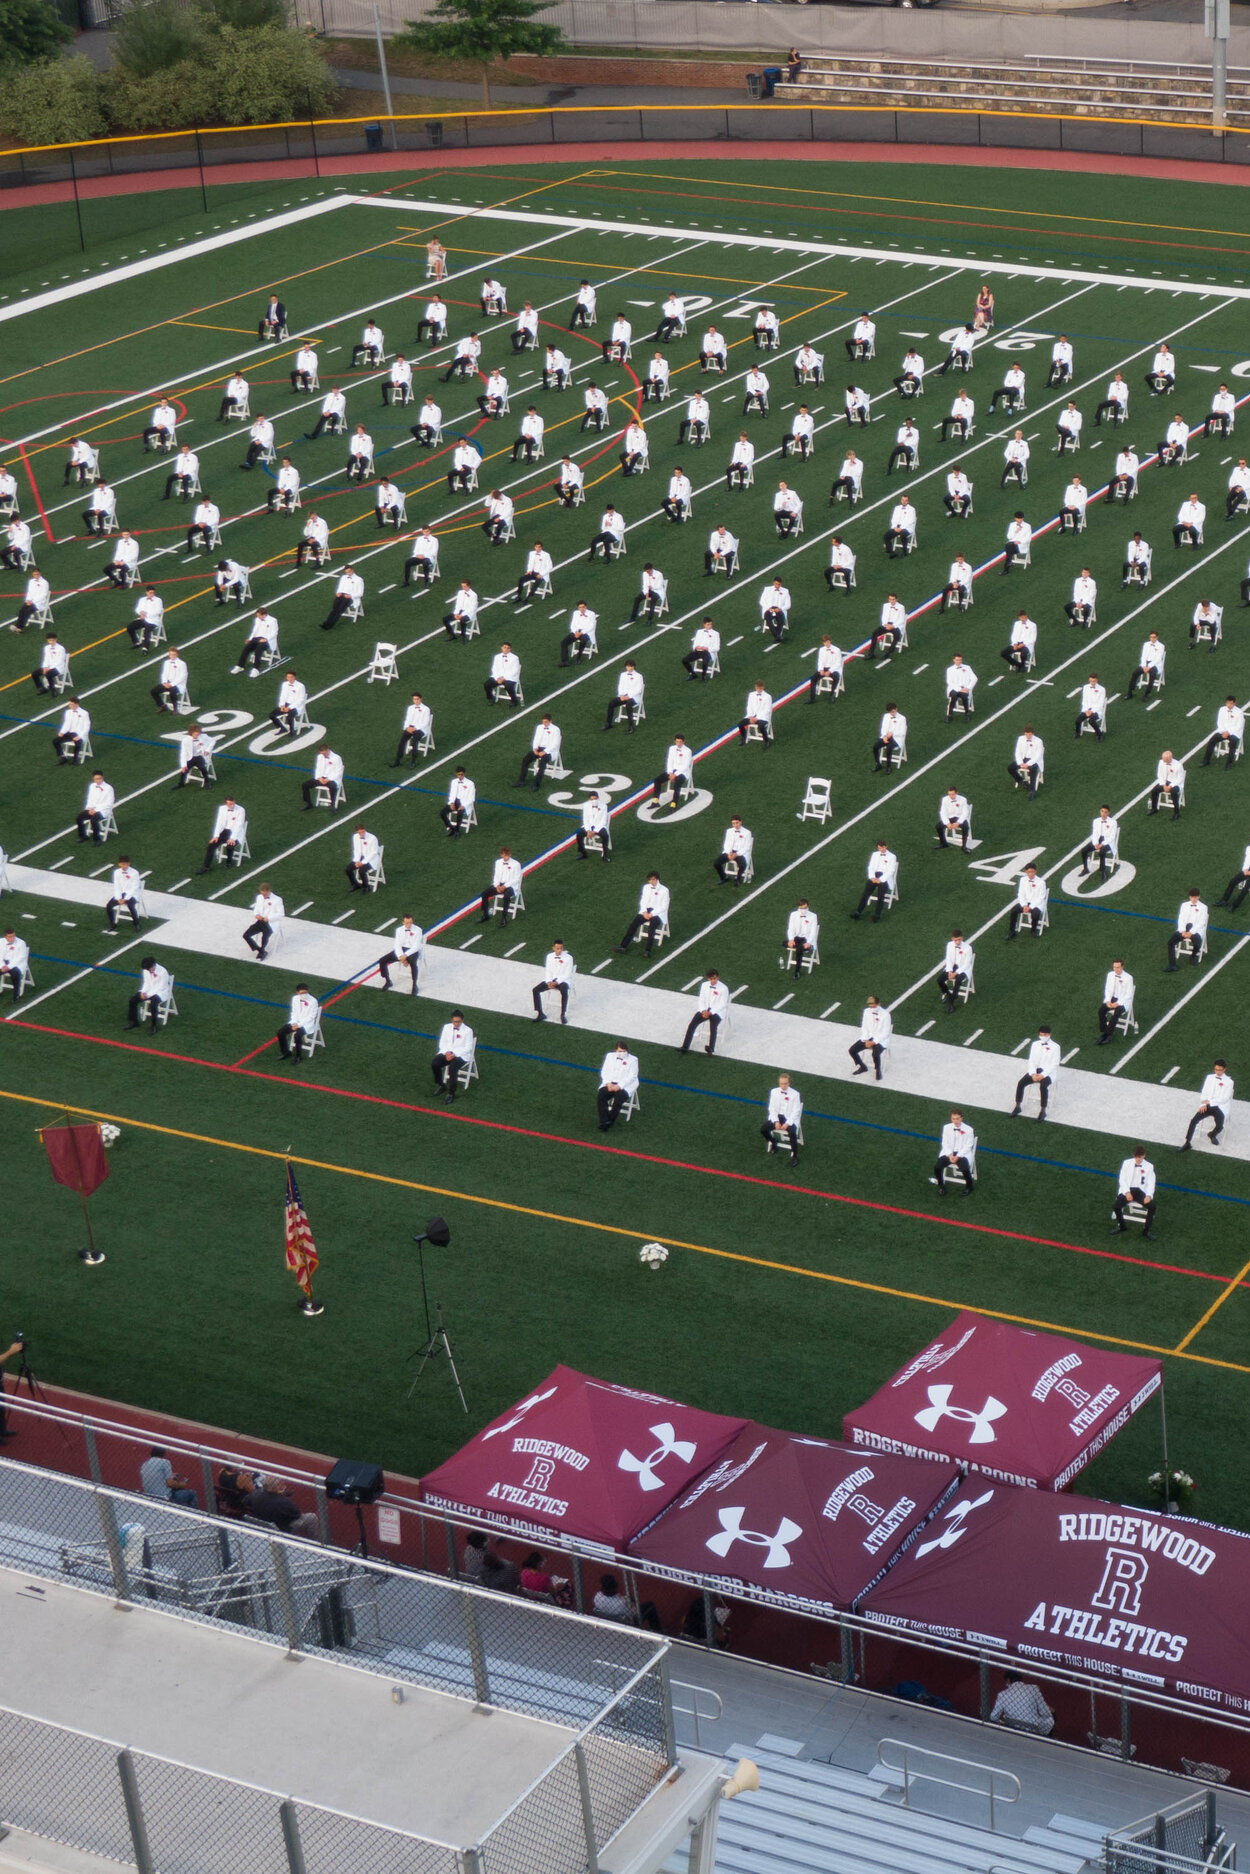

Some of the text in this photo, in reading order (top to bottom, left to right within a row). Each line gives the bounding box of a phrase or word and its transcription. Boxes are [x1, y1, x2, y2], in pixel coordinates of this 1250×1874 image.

[1031, 1353, 1083, 1403] RIDGEWOOD
[1054, 1378, 1091, 1409] R
[1068, 1383, 1121, 1437] ATHLETICS
[512, 1437, 590, 1472] RIDGEWOOD
[852, 1427, 950, 1464] RIDGEWOOD
[1054, 1448, 1089, 1493] PROTECT
[1089, 1433, 1104, 1458] THIS
[522, 1456, 556, 1492] R
[487, 1482, 569, 1517] ATHLETICS
[822, 1466, 875, 1522] RIDGEWOOD
[846, 1494, 886, 1526] R
[862, 1496, 917, 1555] ATHLETICS
[1059, 1513, 1216, 1576] RIDGEWOOD
[1091, 1547, 1149, 1616] R
[865, 1610, 910, 1628] PROTECT
[1023, 1601, 1188, 1662] ATHLETICS
[1017, 1643, 1064, 1663] PROTECT
[1064, 1653, 1083, 1668] THIS
[1175, 1680, 1223, 1703] PROTECT
[1224, 1692, 1242, 1709] THIS
